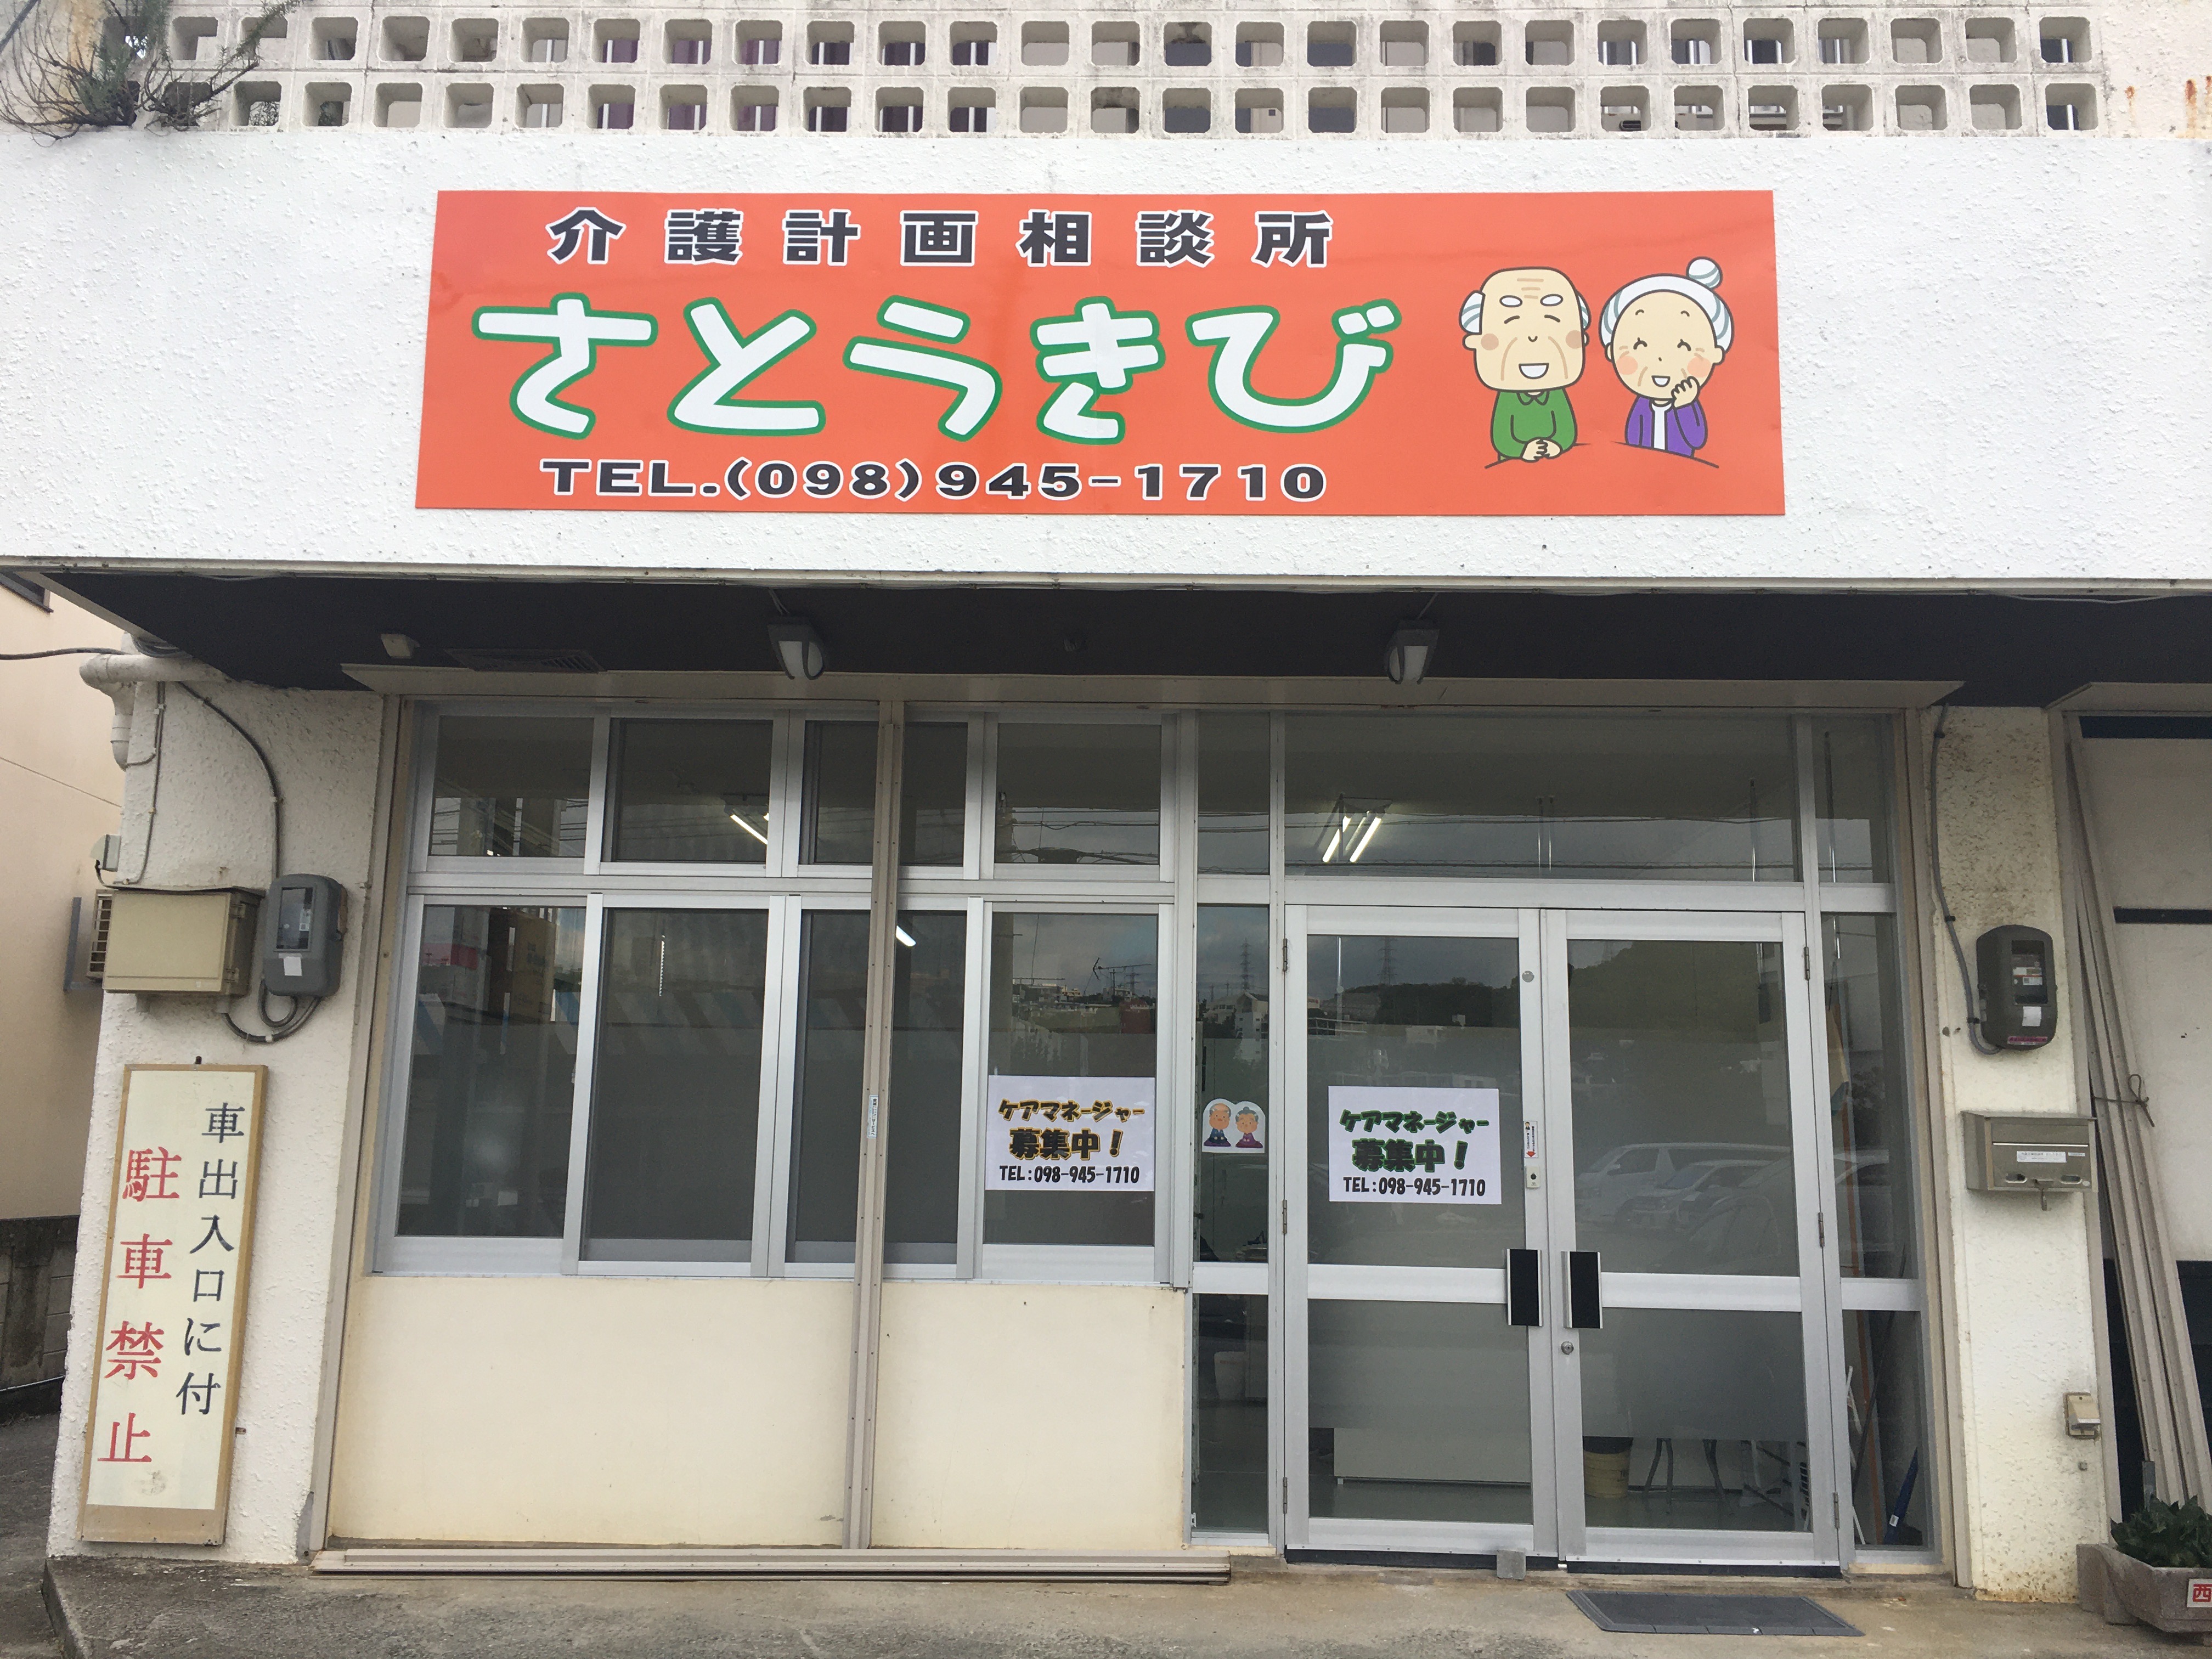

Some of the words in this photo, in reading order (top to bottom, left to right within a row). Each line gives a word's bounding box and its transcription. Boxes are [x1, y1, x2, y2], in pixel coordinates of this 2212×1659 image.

[546, 208, 1332, 267] 介護計画相談所
[471, 291, 1402, 444] さとうきび
[997, 1098, 1146, 1124] ケアマネージャー
[1339, 1109, 1489, 1135] ケアマネージャー
[97, 1146, 182, 1464] 駐車禁止
[175, 1102, 246, 1417] 車出入口に付
